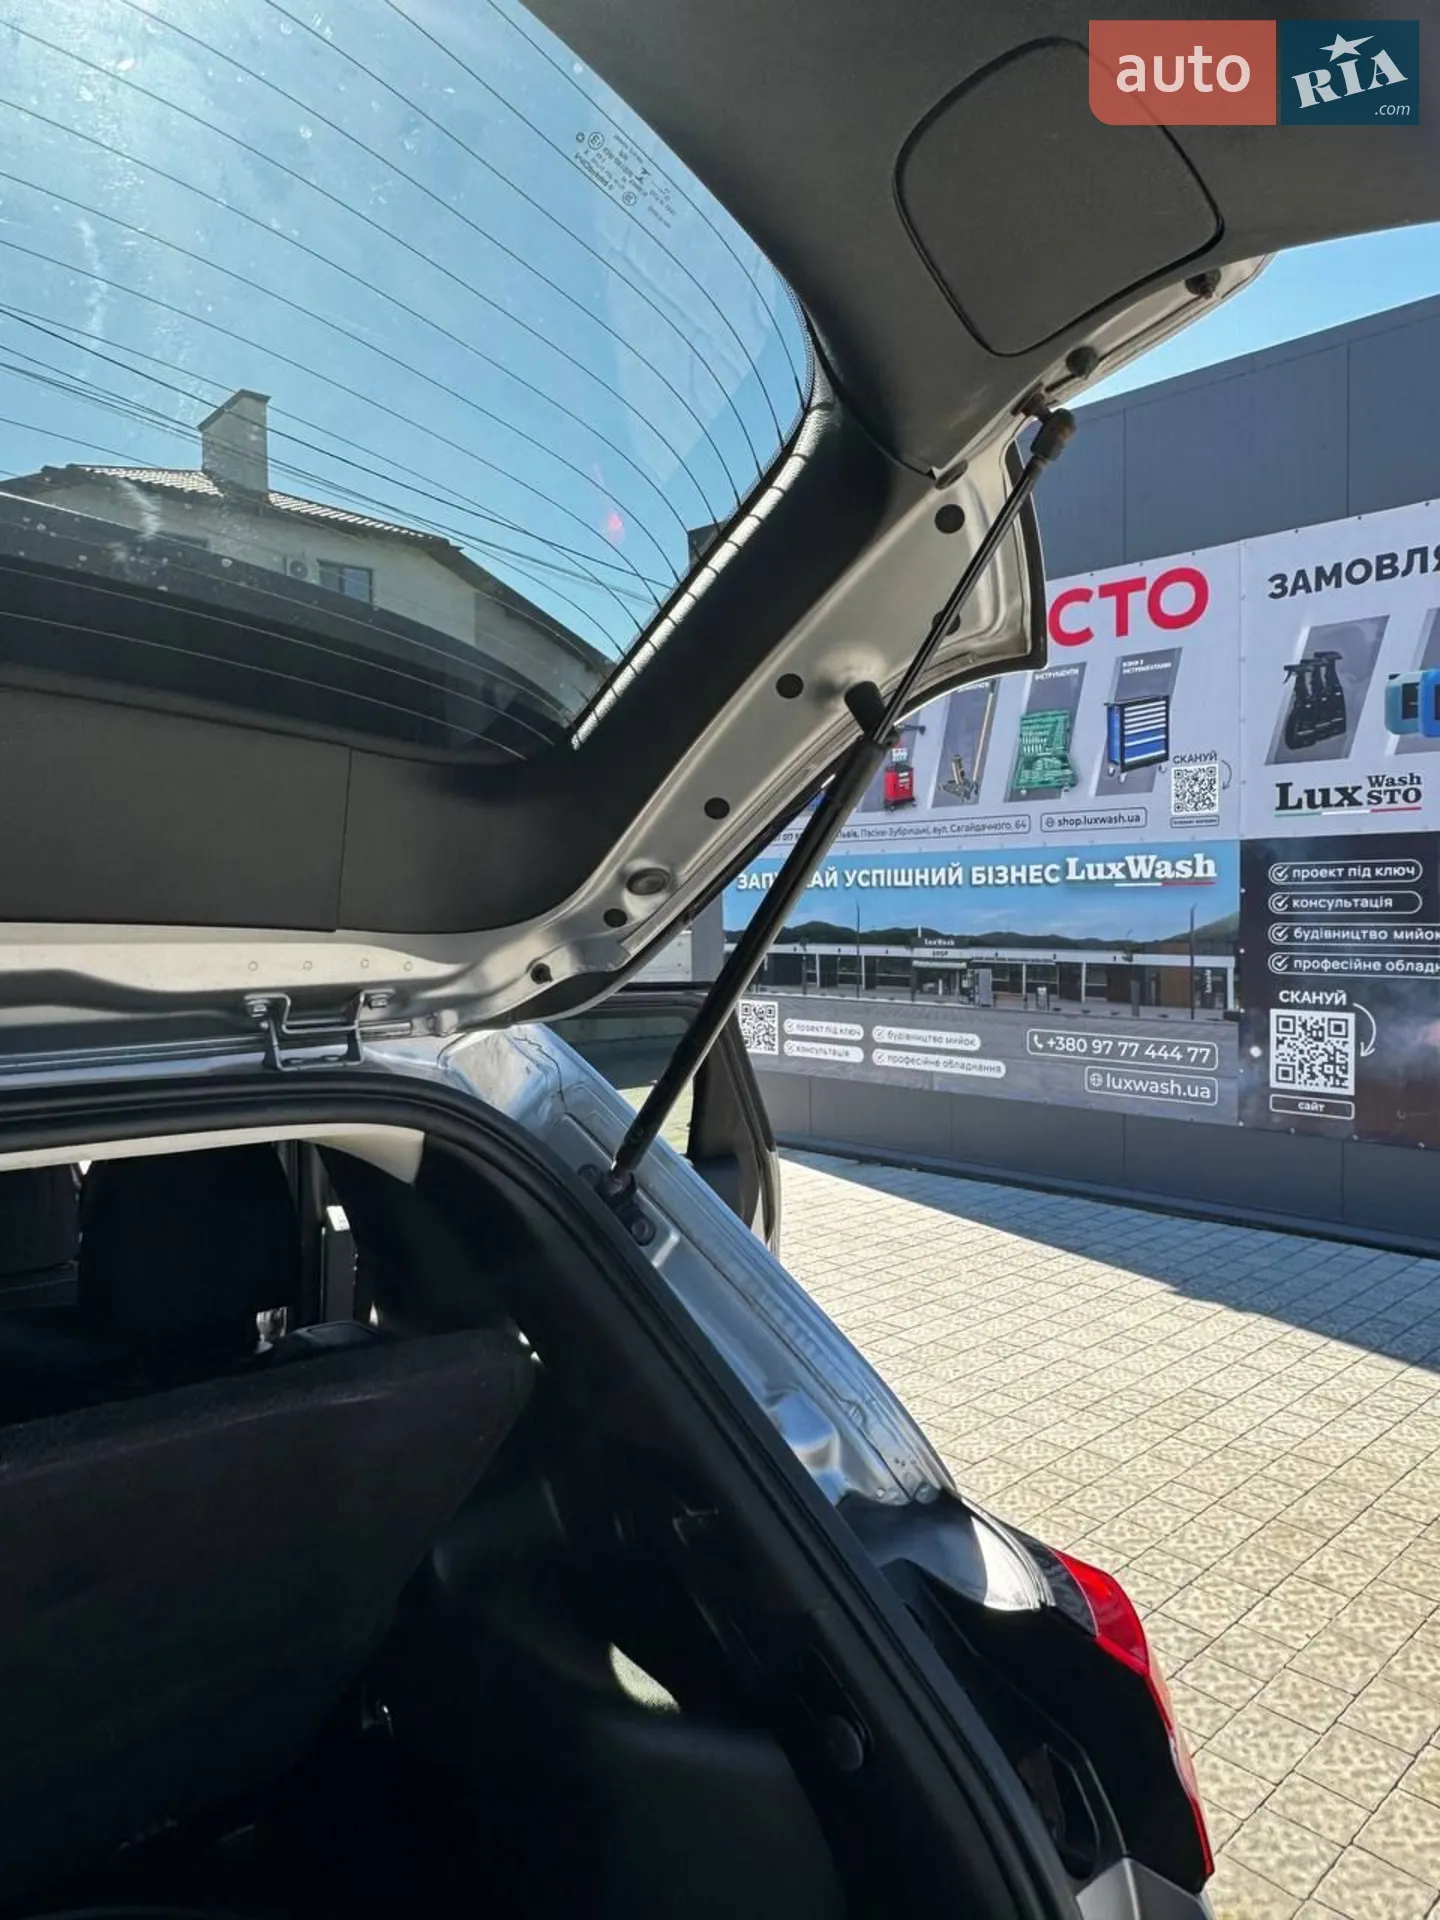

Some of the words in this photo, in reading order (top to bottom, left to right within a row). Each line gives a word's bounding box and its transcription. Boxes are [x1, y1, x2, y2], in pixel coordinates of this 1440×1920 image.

[1048, 567, 1209, 647] СТО
[1173, 750, 1217, 764] СКАНУЙ
[1367, 773, 1422, 788] Wash
[1367, 787, 1422, 806] STO
[1015, 820, 1027, 829] 64
[1057, 814, 1141, 827] shop.luxwash.ua
[1065, 853, 1218, 881] LuxWash
[1292, 868, 1344, 880] проект
[1348, 865, 1371, 878] під
[1375, 865, 1415, 877] ключ
[845, 862, 964, 889] УСПІШНИЙ
[971, 864, 1061, 885] БІЗНЕС
[1292, 896, 1393, 910] консультація
[1293, 928, 1388, 941] будівництво
[1293, 957, 1382, 972] професійне
[1278, 990, 1347, 1006] СКАНУЙ
[1047, 1036, 1087, 1053] +380
[1091, 1039, 1113, 1055] 97
[1117, 1043, 1140, 1057] 77
[1144, 1044, 1182, 1062] 444
[1186, 1047, 1211, 1063] 77
[1106, 1073, 1211, 1099] luxwash.ua
[1298, 1100, 1325, 1112] сайт
